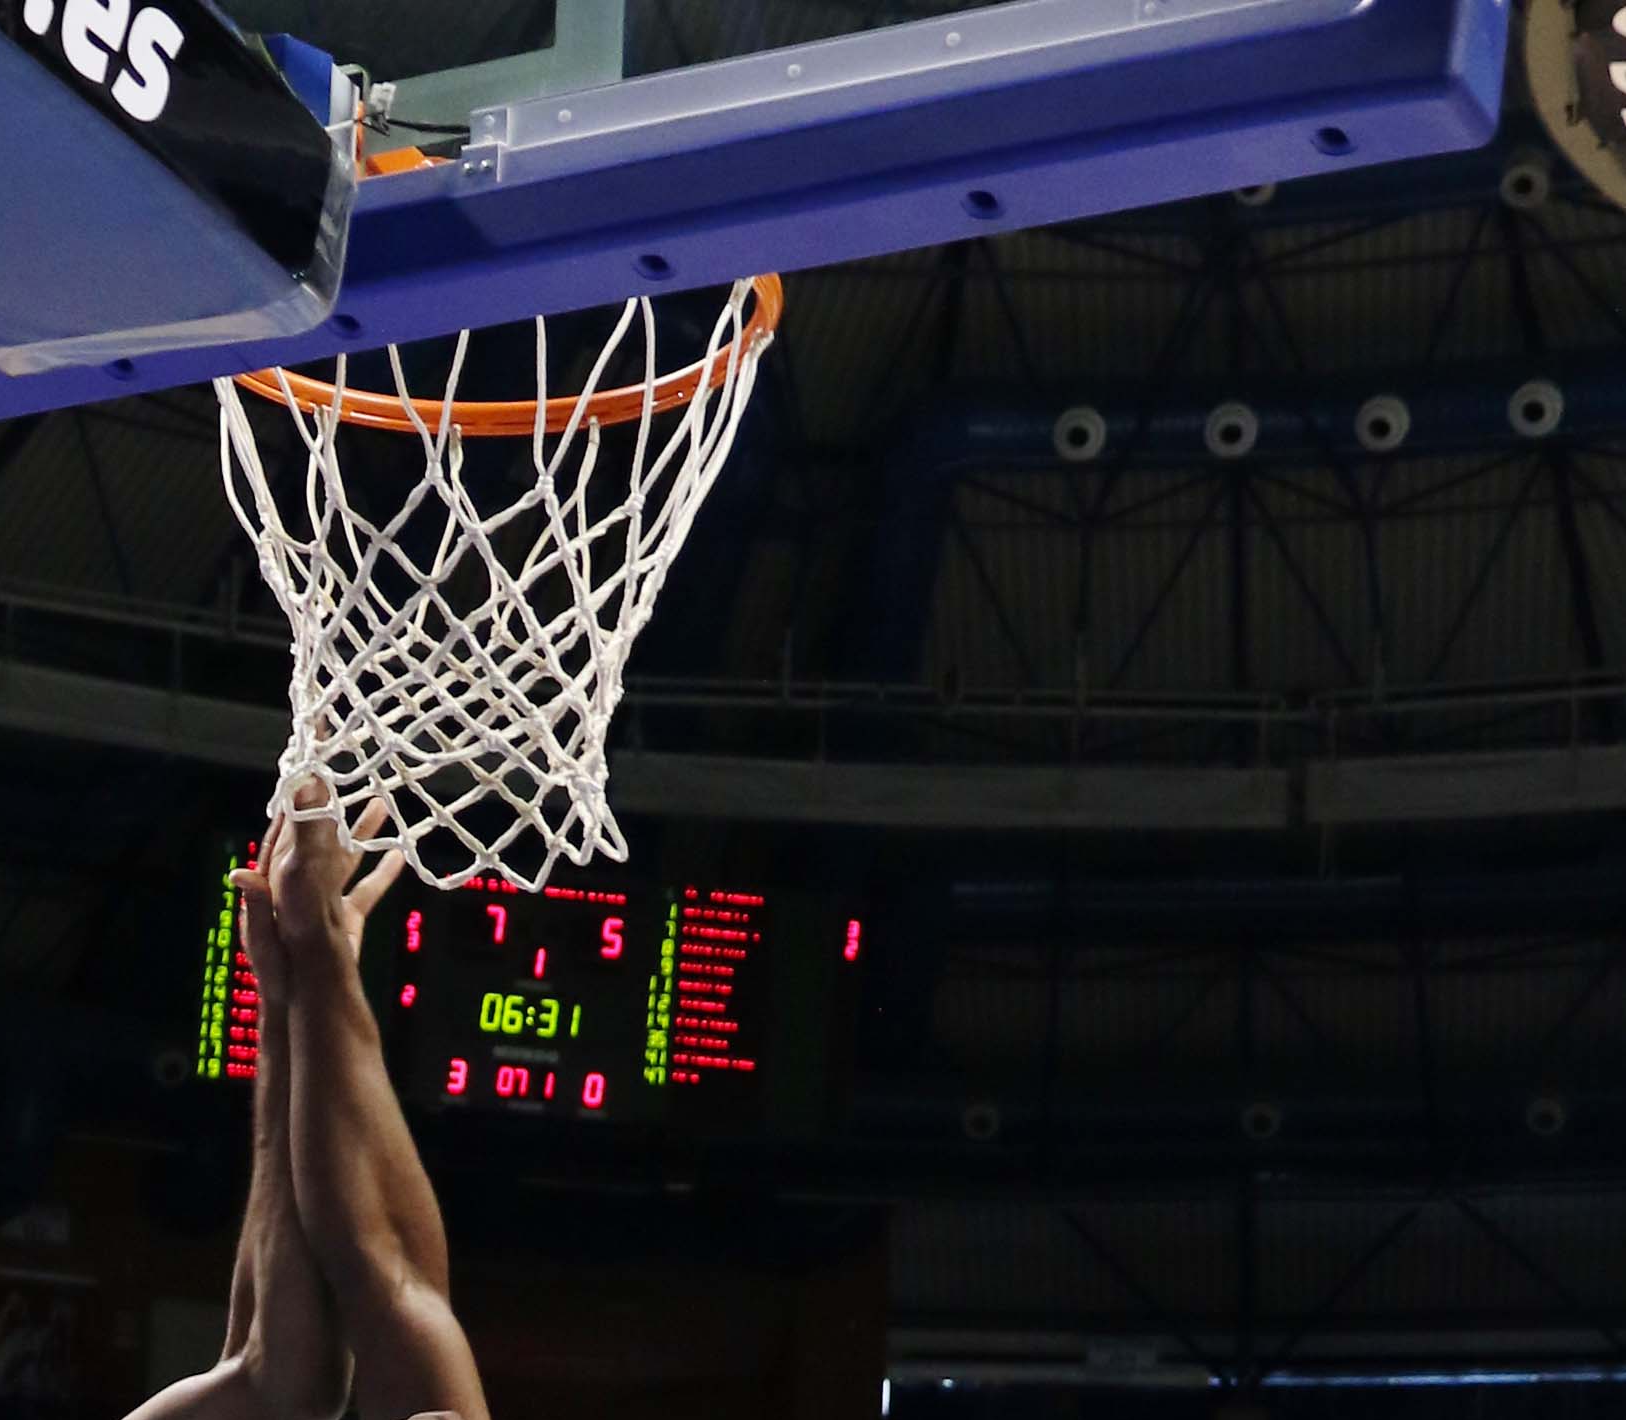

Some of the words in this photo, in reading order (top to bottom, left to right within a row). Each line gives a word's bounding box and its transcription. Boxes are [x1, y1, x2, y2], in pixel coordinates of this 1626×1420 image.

[485, 903, 507, 944] 7
[599, 917, 626, 960] 5
[532, 947, 547, 979] 1
[478, 992, 582, 1039] 06:31
[446, 1057, 469, 1096] 3
[581, 1072, 606, 1111] 0
